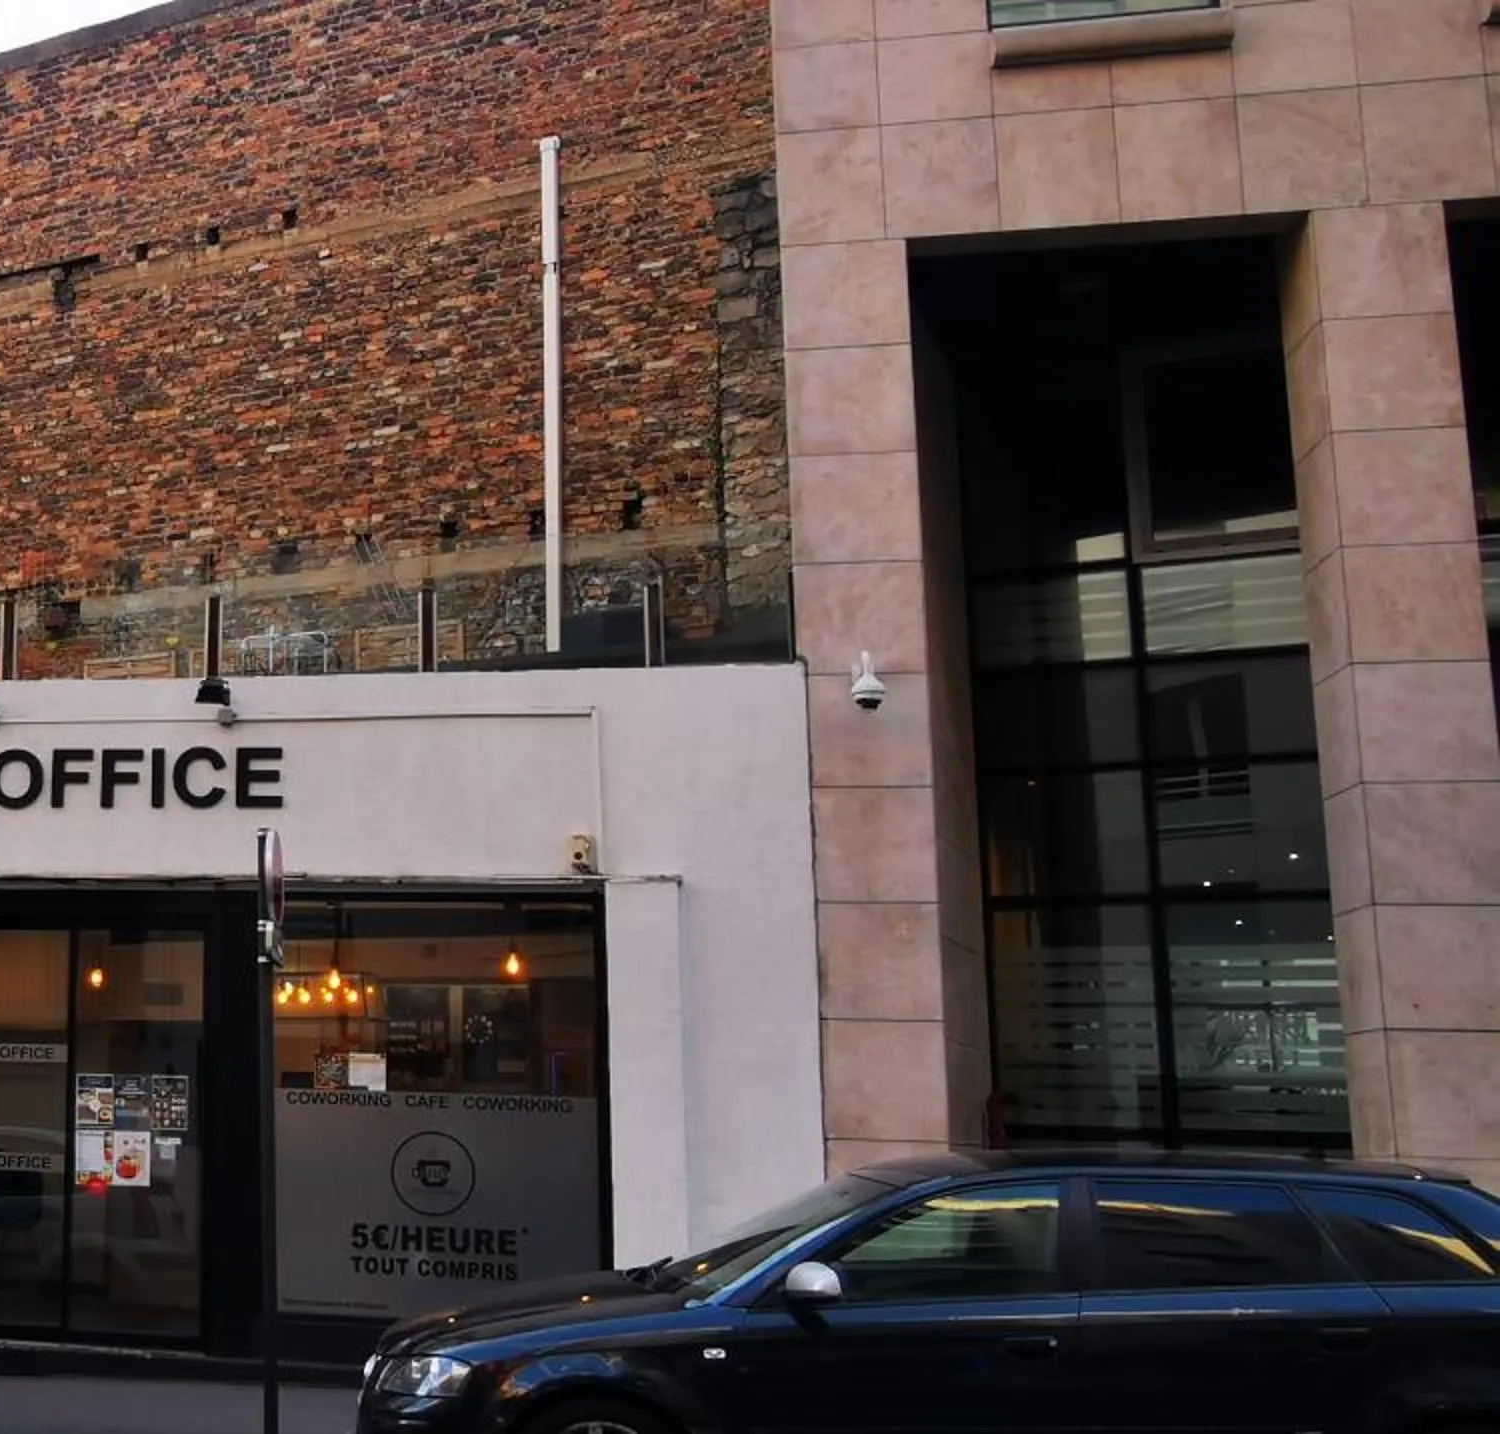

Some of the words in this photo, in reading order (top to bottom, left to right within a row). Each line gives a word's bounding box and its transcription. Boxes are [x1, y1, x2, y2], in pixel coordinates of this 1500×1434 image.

[286, 1090, 392, 1108] COWORKING
[404, 1094, 450, 1109] CAFE
[463, 1095, 574, 1114] COWORKING
[351, 1256, 409, 1276] TOUT
[417, 1258, 518, 1281] COMPRIS
